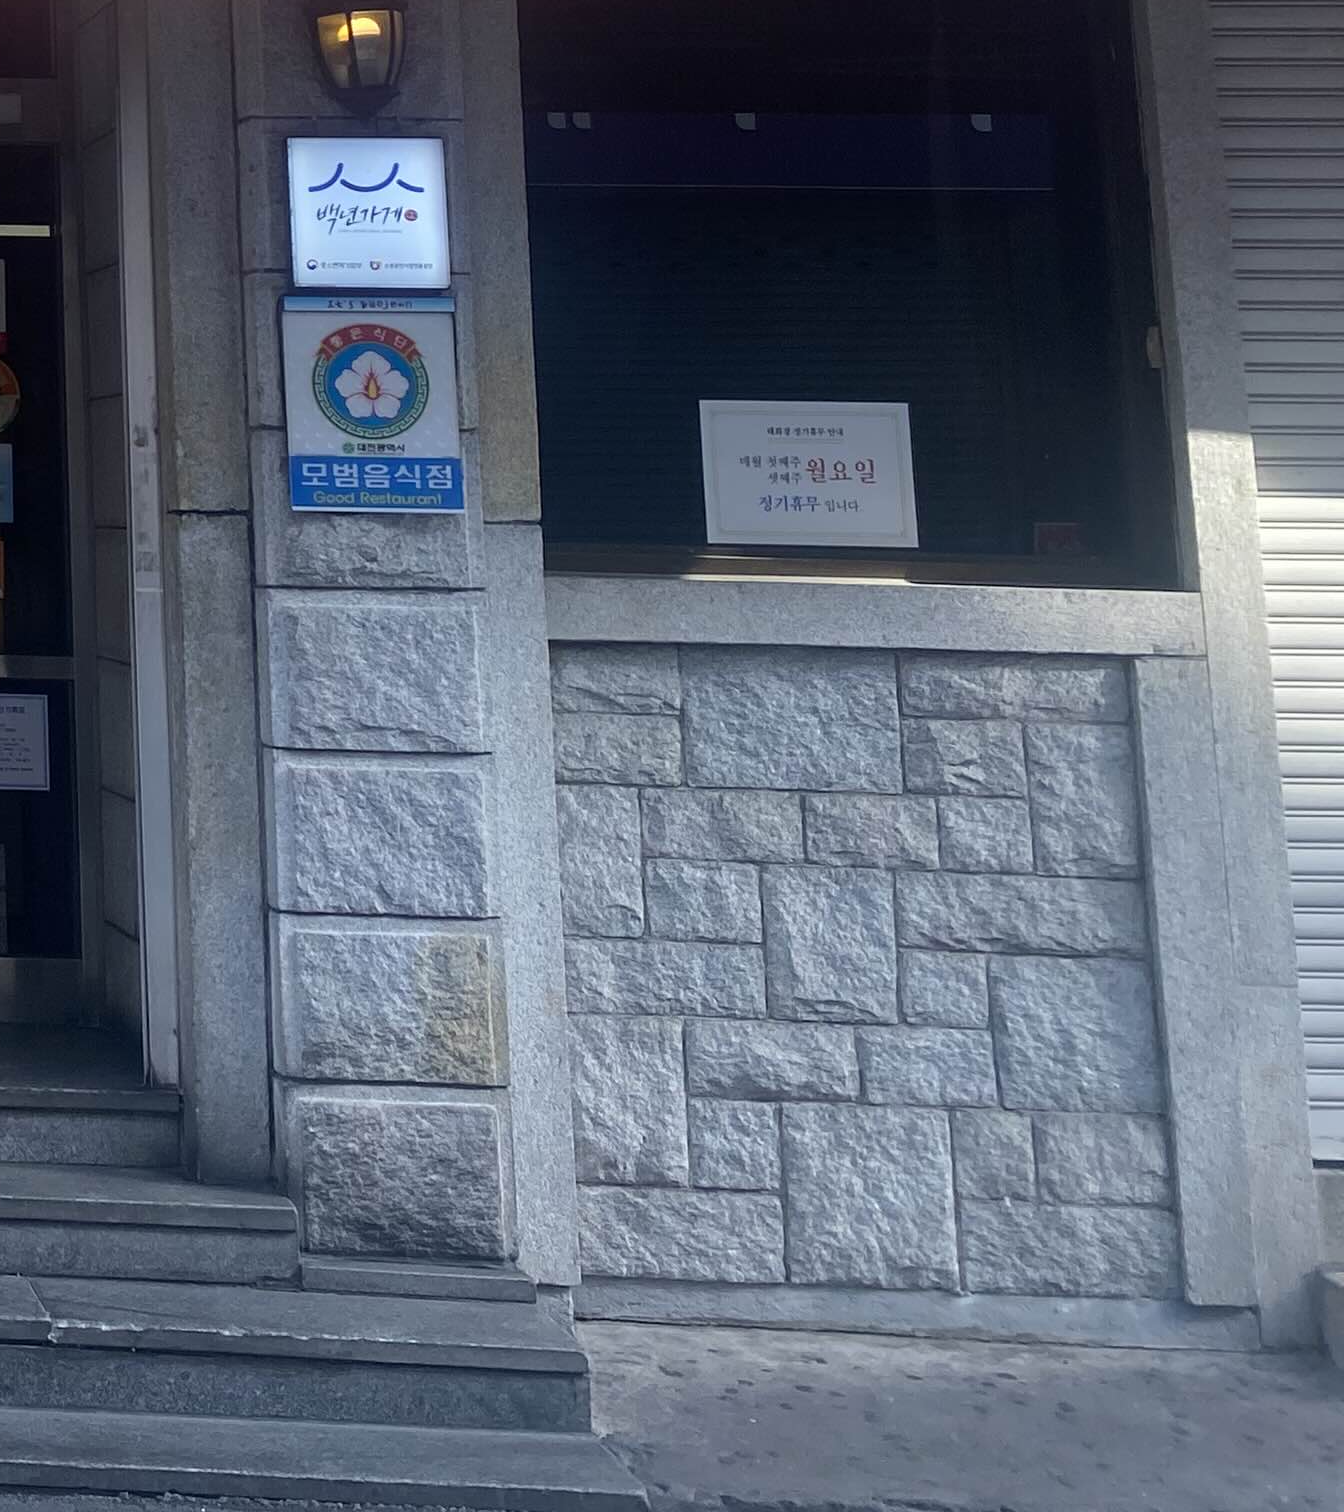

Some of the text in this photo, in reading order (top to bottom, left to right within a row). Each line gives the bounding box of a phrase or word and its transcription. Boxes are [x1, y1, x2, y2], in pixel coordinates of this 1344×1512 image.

[316, 203, 404, 235] 백년가게
[356, 443, 406, 453] 대전광역시
[301, 463, 453, 490] 모범음식점
[739, 455, 877, 484] 매월 첫째주 월요일
[768, 471, 802, 486] 셋째주
[313, 491, 443, 505] Good Restaurant
[759, 495, 821, 512] 정기휴무
